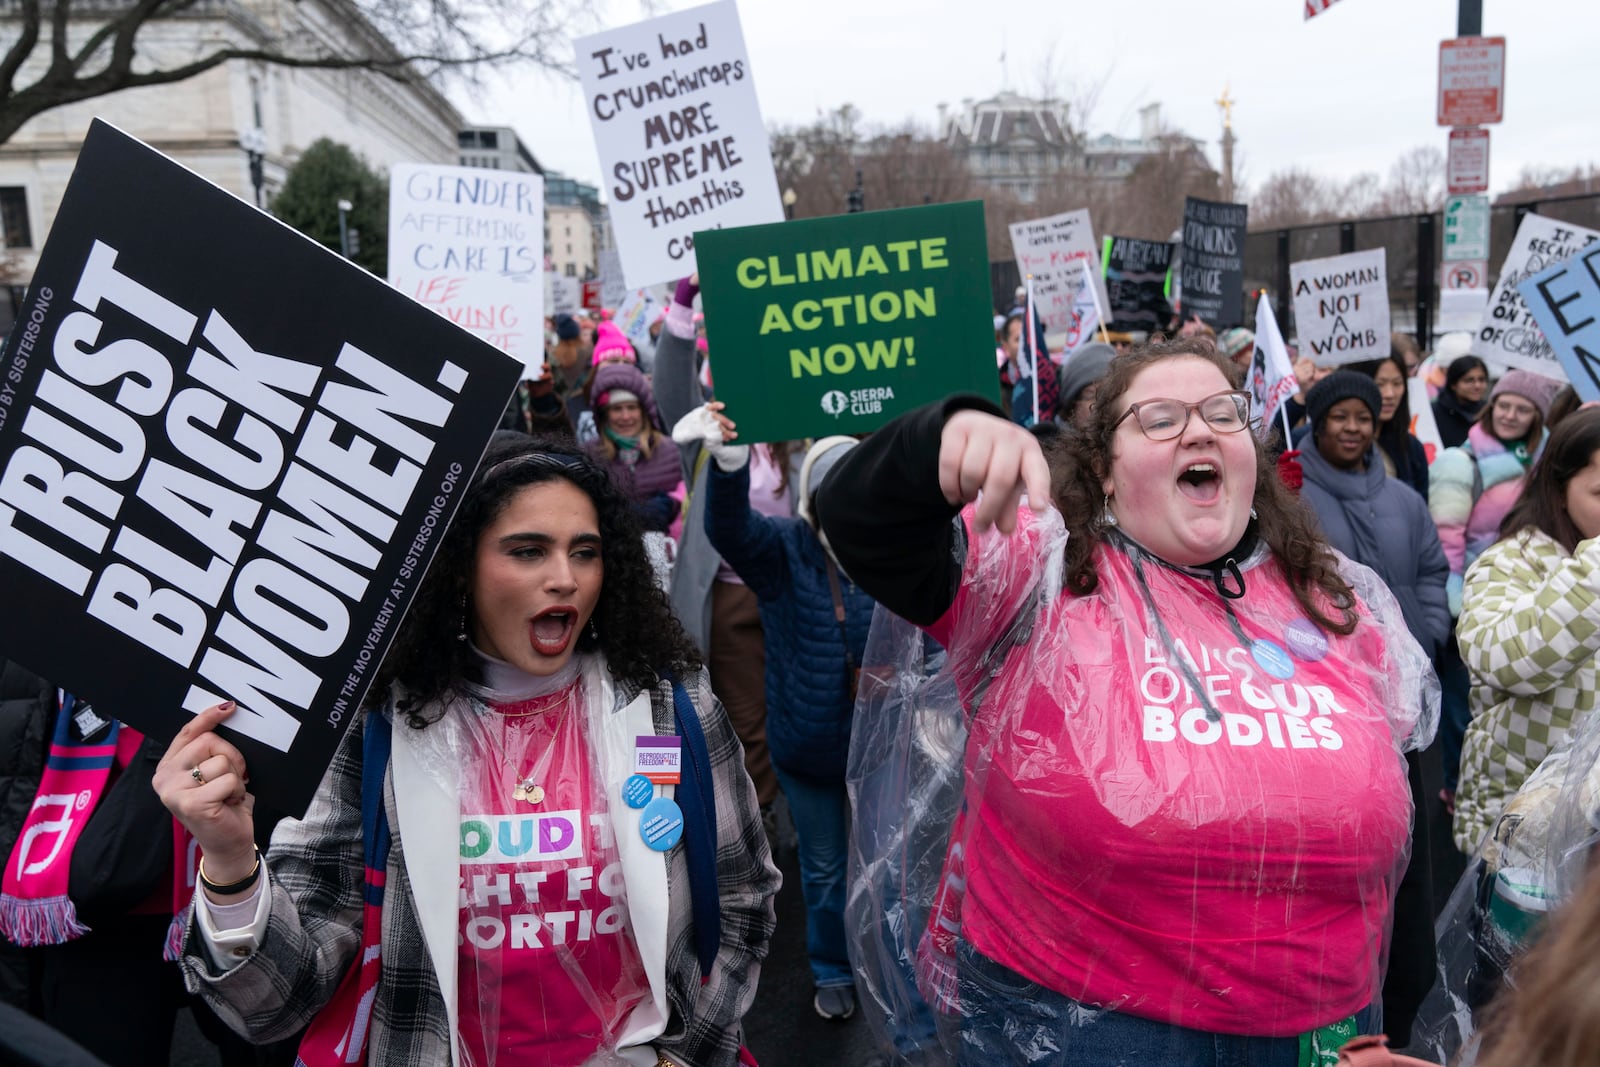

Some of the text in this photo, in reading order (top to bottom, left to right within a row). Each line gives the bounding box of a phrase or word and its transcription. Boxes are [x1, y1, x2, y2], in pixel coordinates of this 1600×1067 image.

[592, 23, 708, 80] I've had
[594, 59, 744, 121] Crunchwraps
[644, 102, 719, 150] MORE
[613, 136, 743, 202] SUPREME
[407, 172, 534, 216] GENDER
[400, 212, 525, 241] AFFIRMING
[1552, 228, 1574, 243] IF
[414, 244, 537, 275] CARE IS
[736, 237, 949, 289] CLIMATE
[1296, 266, 1378, 296] A WOMAN
[437, 304, 519, 330] VING
[759, 287, 937, 335] ACTION
[1319, 293, 1361, 318] NOT
[1332, 316, 1349, 335] A
[1493, 305, 1518, 322] ON
[1, 286, 54, 407] BY SISTERSONG
[1310, 329, 1376, 355] WOMB
[1480, 326, 1503, 344] OF
[790, 337, 916, 379] NOW!
[850, 387, 894, 403] SIERRA
[851, 401, 882, 415] CLUB
[0, 239, 198, 596] TRUST
[87, 308, 323, 668] BLACK
[182, 342, 469, 753] WOMEN.
[327, 461, 462, 729] JOIN THE MOVEMENT AT SISTERSONG.ORG
[1240, 682, 1348, 718] OUR
[1142, 705, 1344, 751] BODIES
[458, 905, 627, 950] ORTIO
